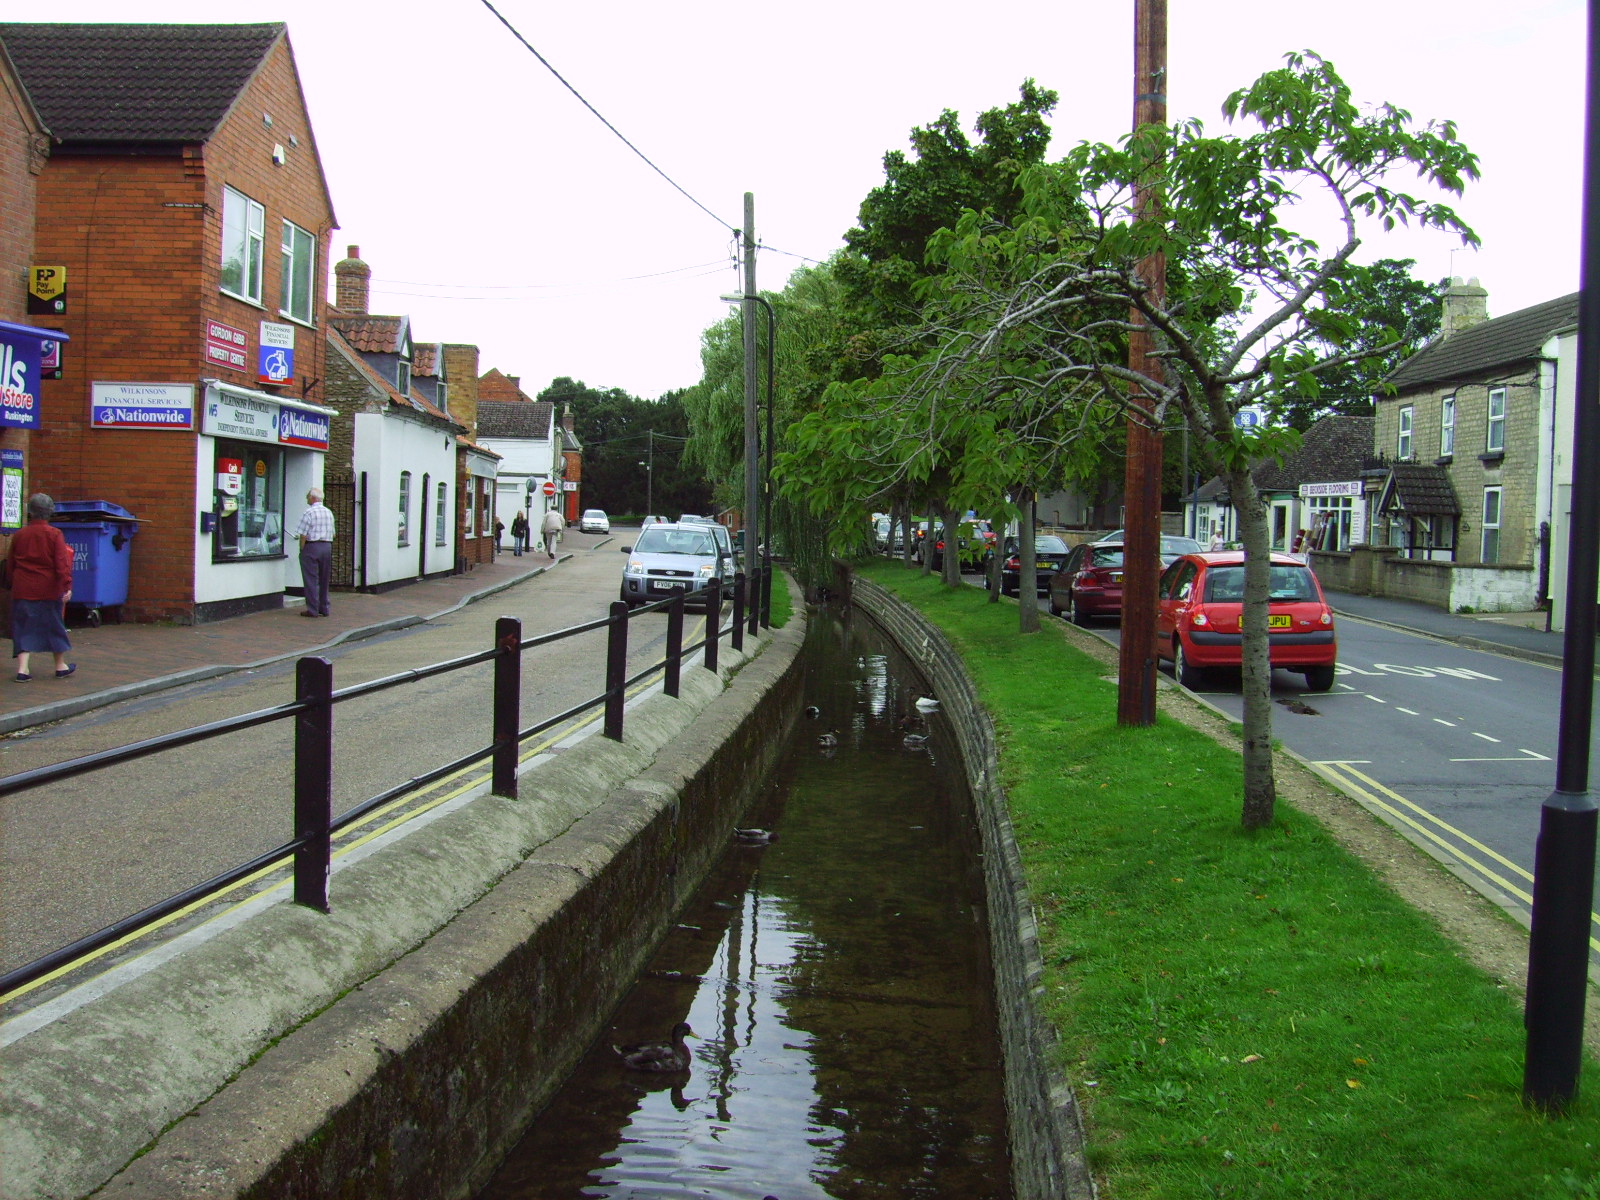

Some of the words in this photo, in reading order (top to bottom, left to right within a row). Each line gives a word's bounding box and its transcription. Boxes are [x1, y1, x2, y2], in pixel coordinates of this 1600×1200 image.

[210, 324, 232, 341] GORDON
[233, 332, 245, 345] GIBB
[266, 331, 289, 339] FINANCIAL
[209, 346, 230, 362] PROPERTY
[230, 352, 245, 366] CENTRE
[5, 411, 33, 423] Ruskington
[115, 408, 184, 422] Nationwide
[289, 411, 327, 440] Nationwide
[1270, 617, 1286, 625] JPU
